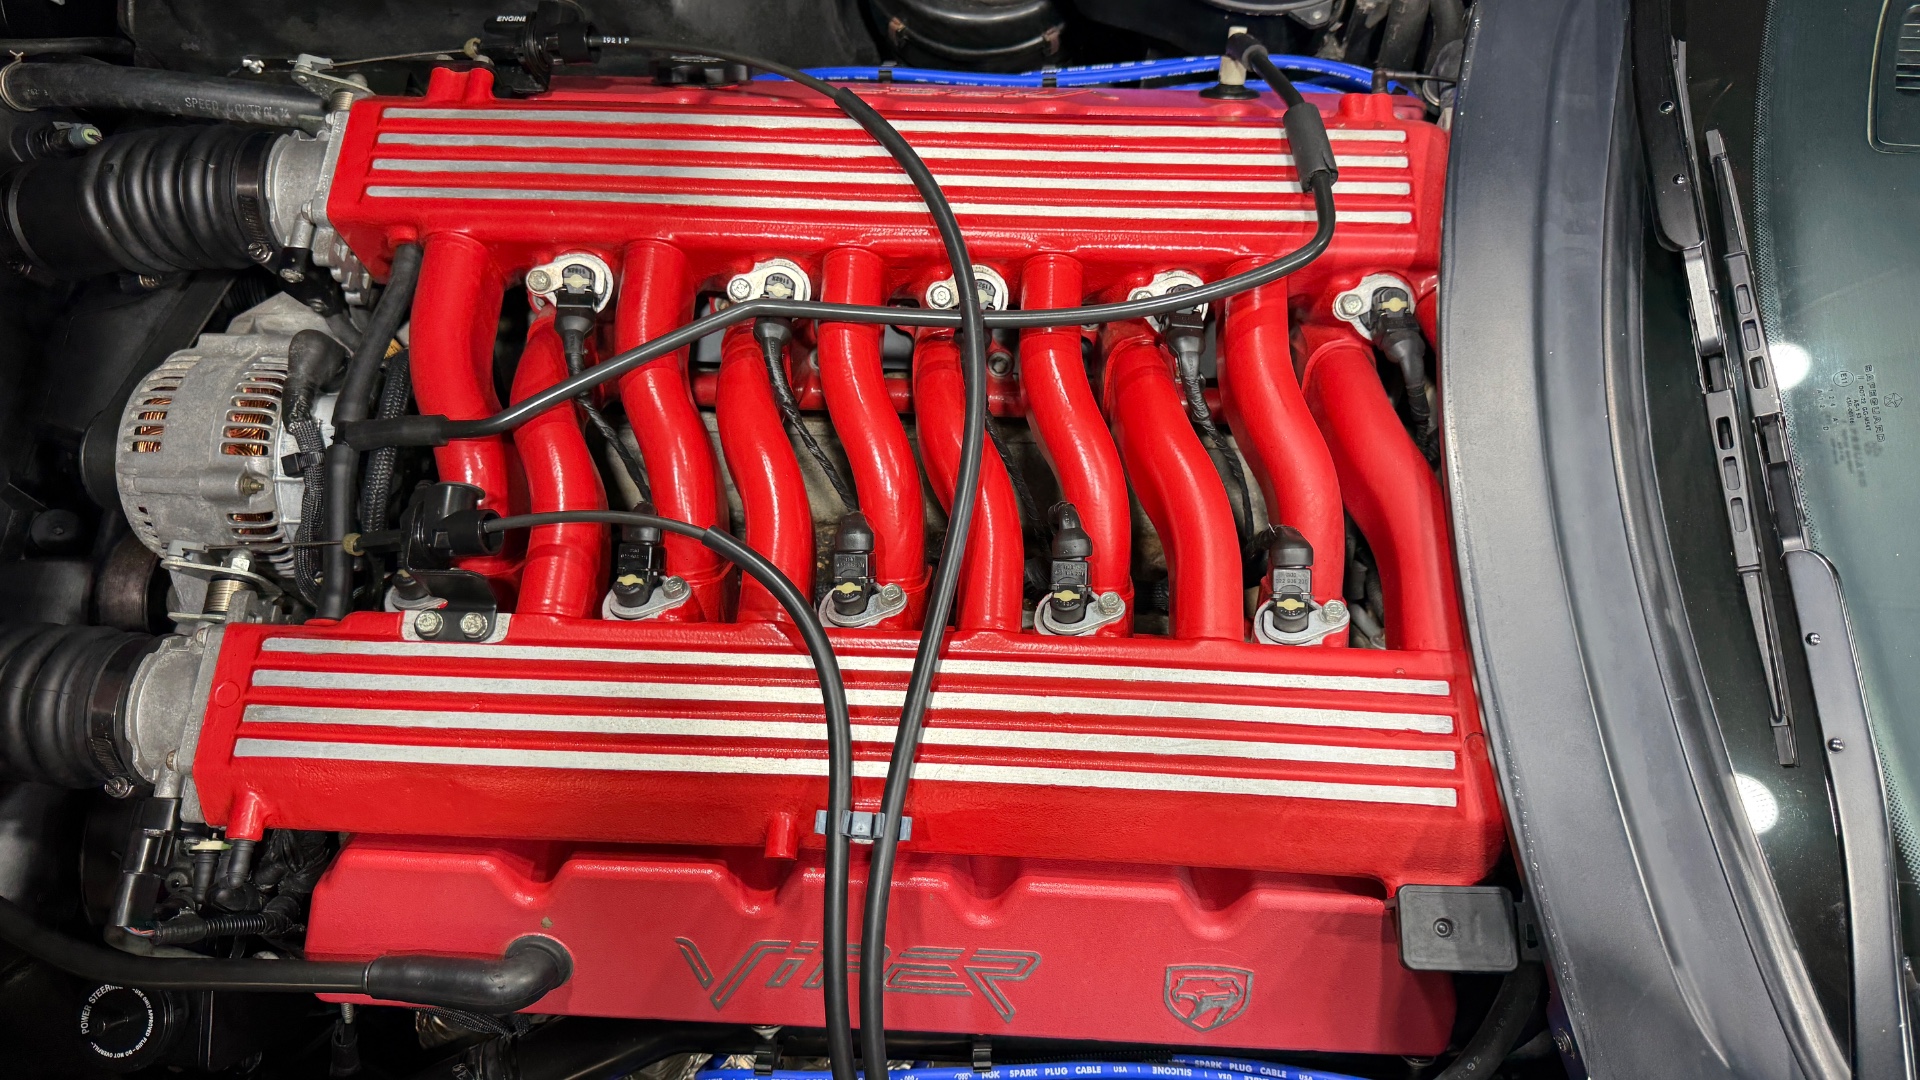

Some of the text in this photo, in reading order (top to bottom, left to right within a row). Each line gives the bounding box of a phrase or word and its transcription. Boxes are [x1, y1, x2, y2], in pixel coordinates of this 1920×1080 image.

[496, 15, 527, 23] ENGINE
[184, 96, 218, 111] SPEED
[1840, 372, 1848, 384] E11
[1864, 364, 1885, 442] SAFEGUARD
[80, 984, 124, 1035] POWER STEER
[981, 1070, 1000, 1079] NGK
[1009, 1068, 1038, 1078] SPARK
[1045, 1066, 1068, 1077] PLUG
[1075, 1065, 1102, 1075] CABLE
[1152, 1066, 1192, 1077] SILICONE
[1195, 1059, 1223, 1070] SPARK
[1229, 1061, 1253, 1073] PLUG
[1260, 1067, 1287, 1078] CABLE
